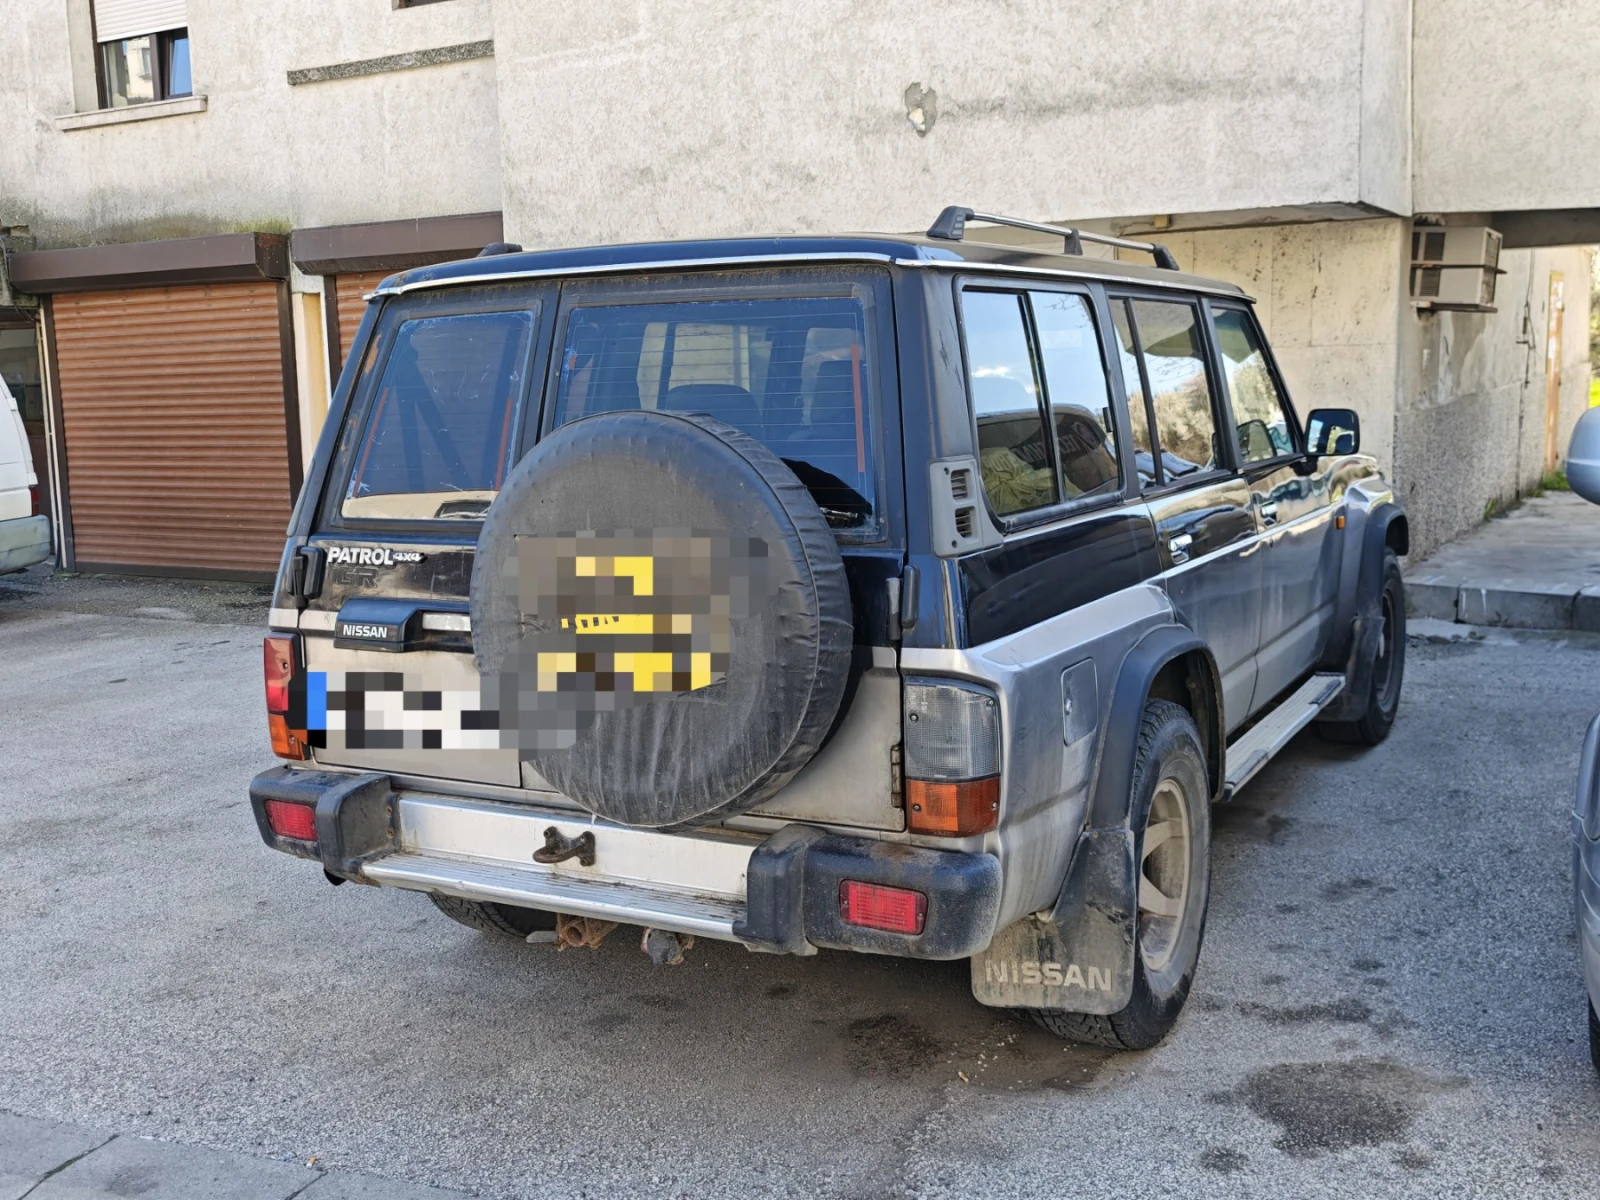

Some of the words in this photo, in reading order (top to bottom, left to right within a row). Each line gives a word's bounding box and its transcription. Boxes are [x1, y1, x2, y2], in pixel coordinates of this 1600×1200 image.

[327, 546, 394, 566] PATROL
[342, 624, 387, 639] NISSAN
[984, 959, 1113, 991] NISSAN
